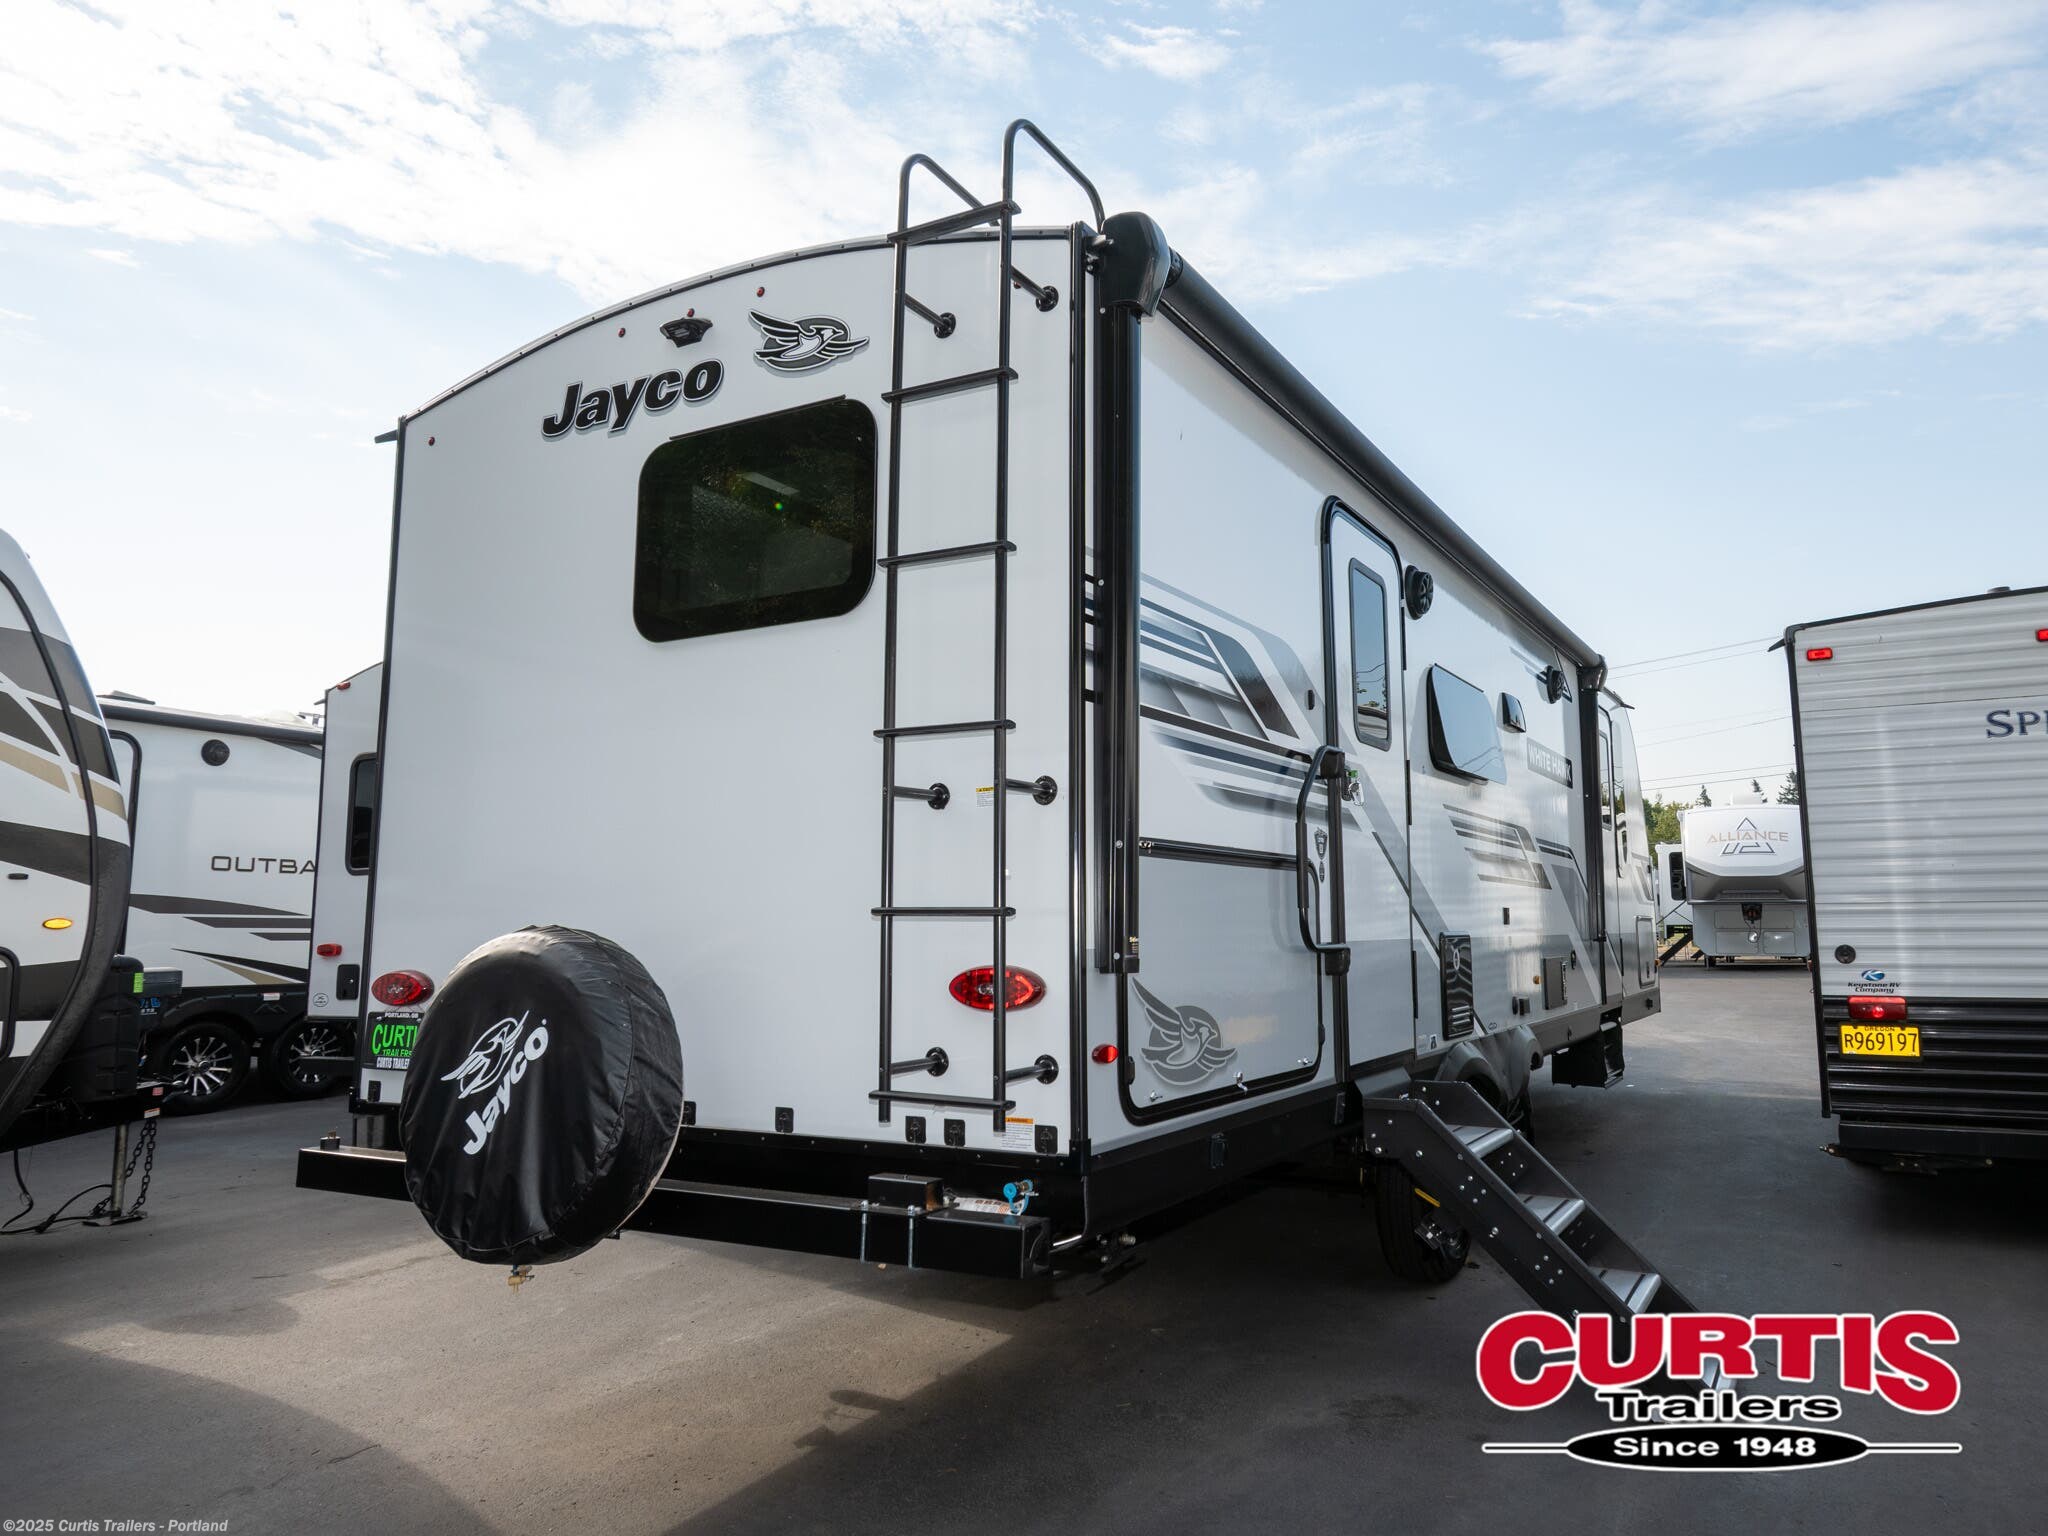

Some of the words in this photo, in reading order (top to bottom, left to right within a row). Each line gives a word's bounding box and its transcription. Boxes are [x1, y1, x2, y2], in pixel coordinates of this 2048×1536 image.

[542, 358, 724, 438] Jayco
[1707, 830, 1789, 843] ALLIANCE
[1844, 1031, 1918, 1052] R969197
[463, 1026, 549, 1155] Jayco
